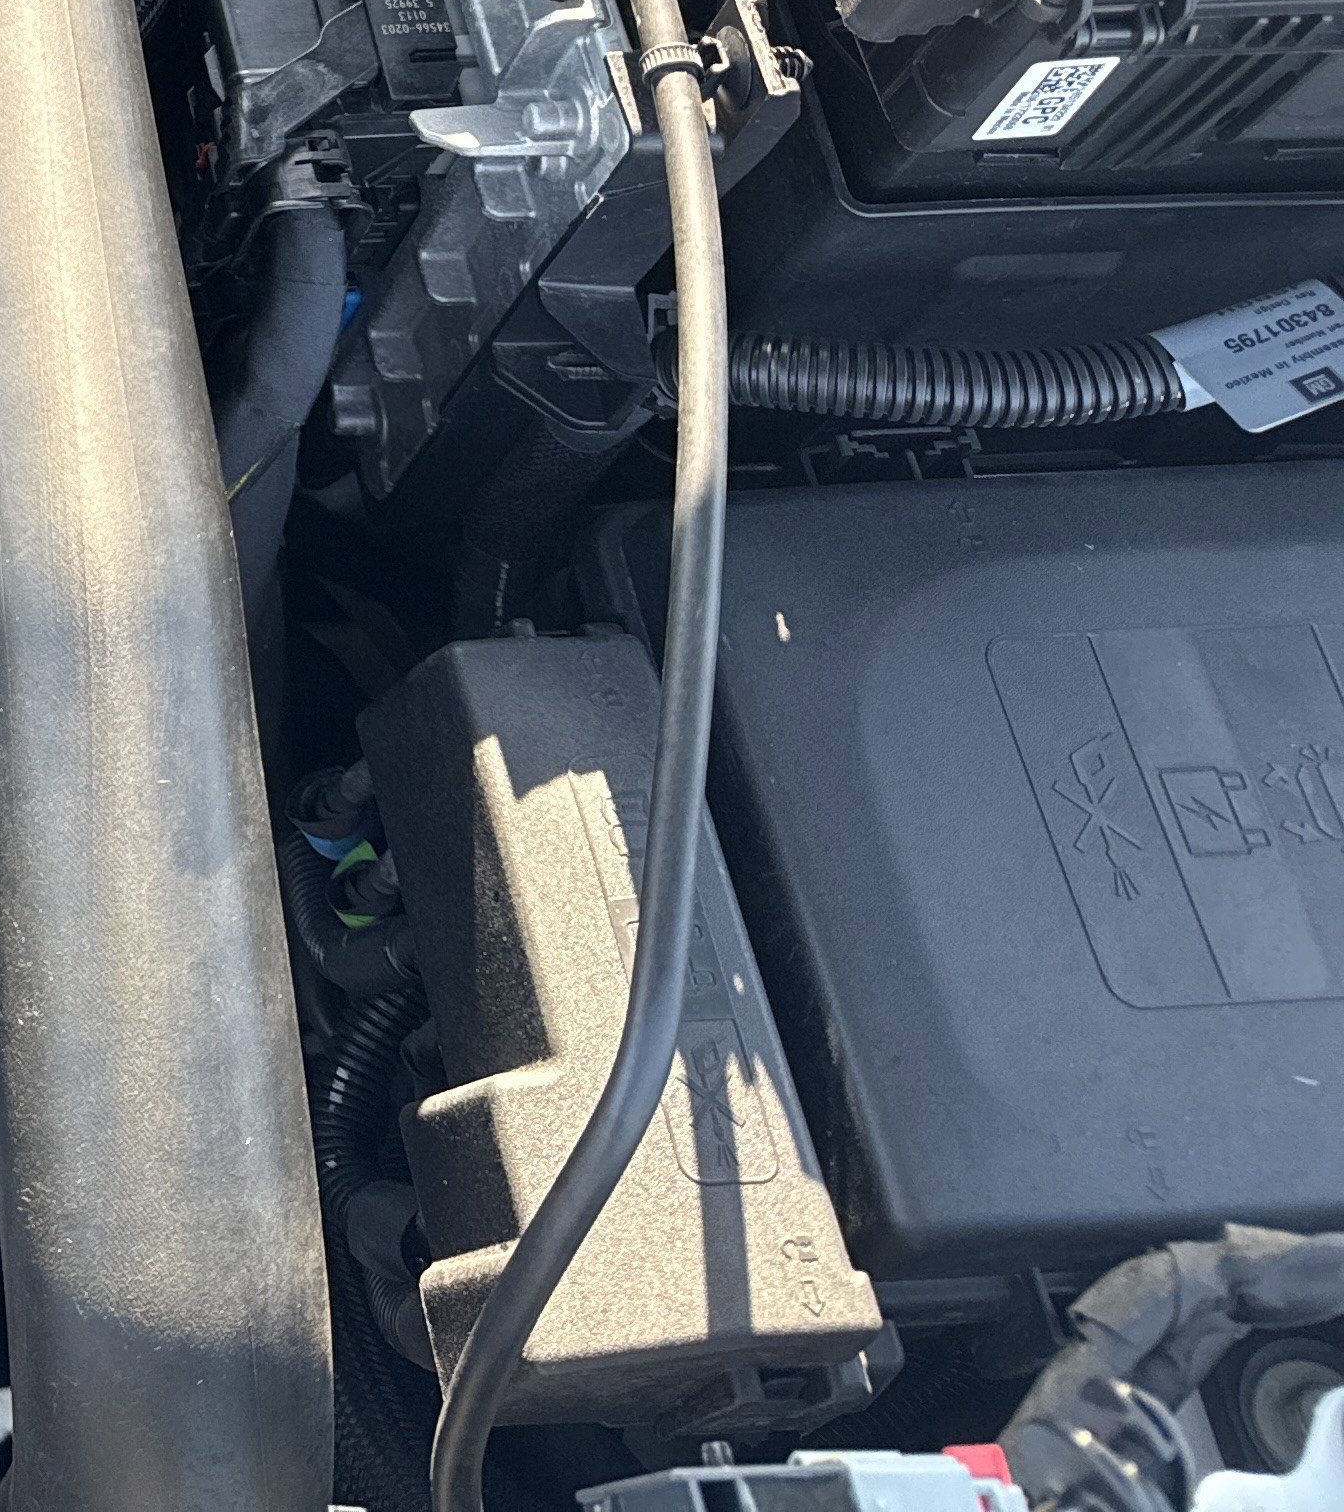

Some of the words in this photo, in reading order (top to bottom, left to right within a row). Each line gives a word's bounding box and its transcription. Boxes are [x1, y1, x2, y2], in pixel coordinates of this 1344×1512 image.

[397, 10, 427, 22] 0113
[1021, 96, 1066, 125] GPC
[1223, 303, 1335, 354] 84301795
[1291, 337, 1344, 364] ssembly
[1224, 366, 1274, 390] Mexico
